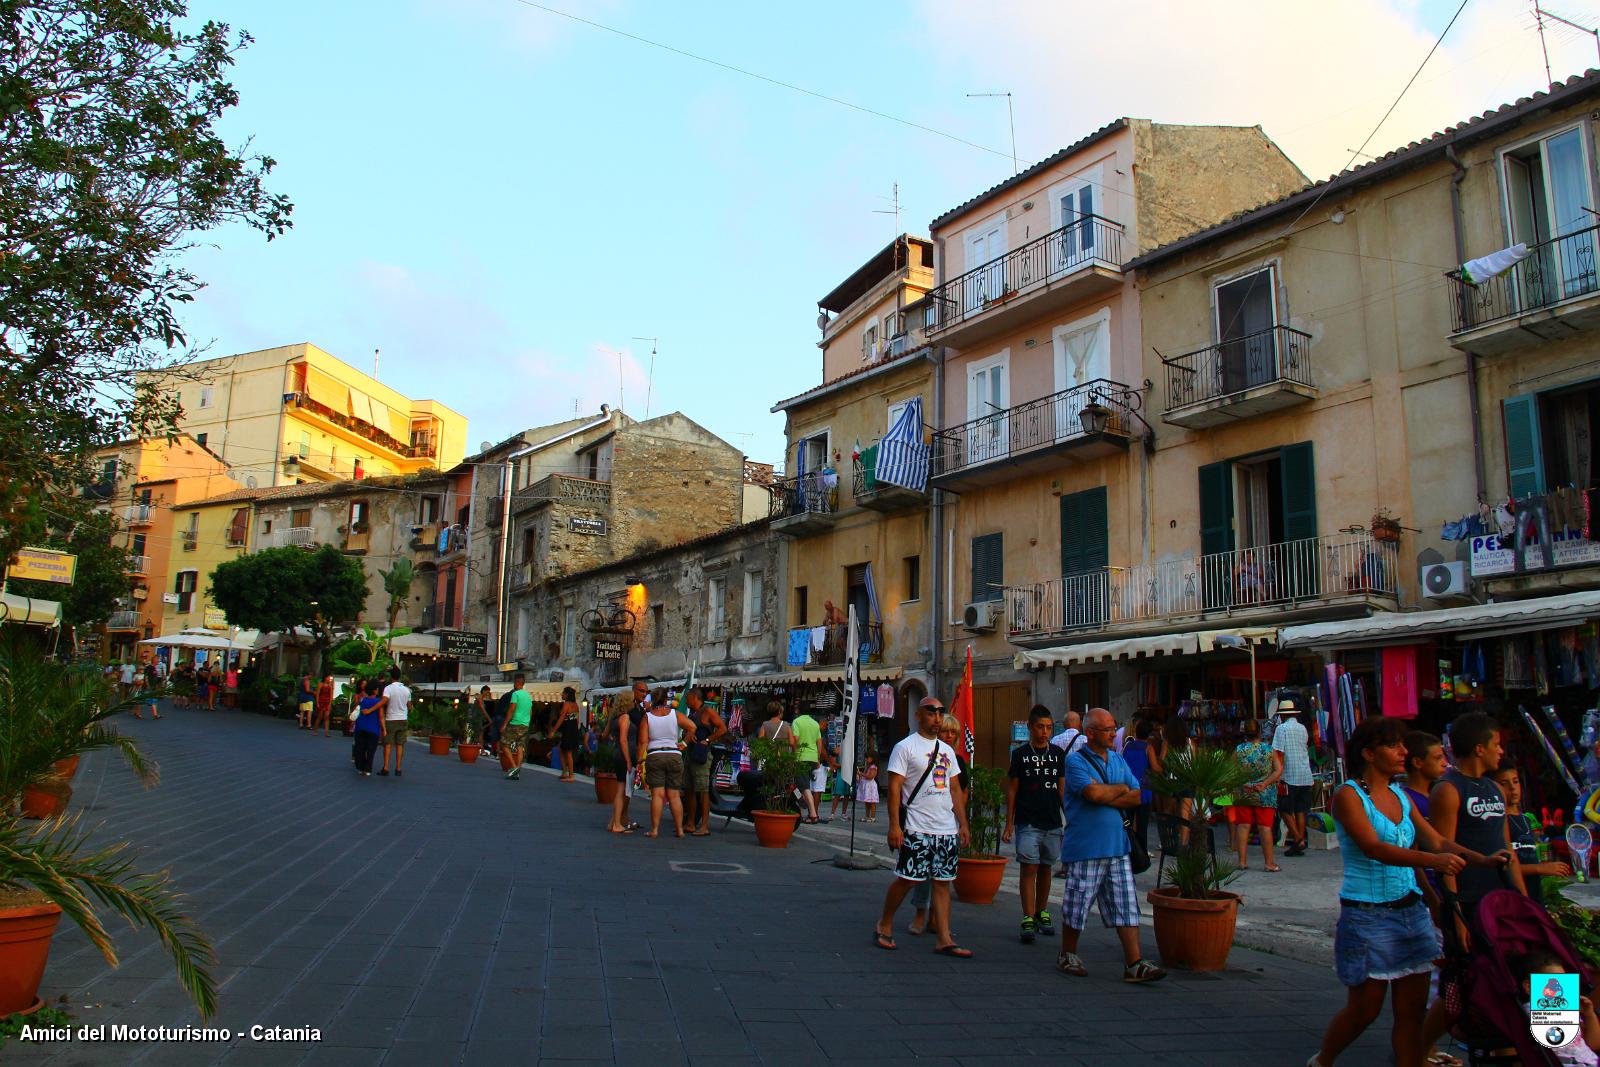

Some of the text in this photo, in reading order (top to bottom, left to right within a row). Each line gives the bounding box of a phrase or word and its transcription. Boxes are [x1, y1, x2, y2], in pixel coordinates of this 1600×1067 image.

[16, 551, 61, 562] ISTORANTE
[28, 561, 67, 572] PIZZERIA
[1474, 559, 1509, 570] RICARICA
[51, 575, 70, 584] BAR
[447, 635, 481, 643] TRATTORIA
[596, 641, 621, 651] Trattoria
[448, 647, 478, 655] BOTTE
[596, 649, 621, 659] La Botte
[1022, 754, 1058, 763] HOLLI
[1025, 768, 1058, 777] STER
[1044, 781, 1058, 790] CA
